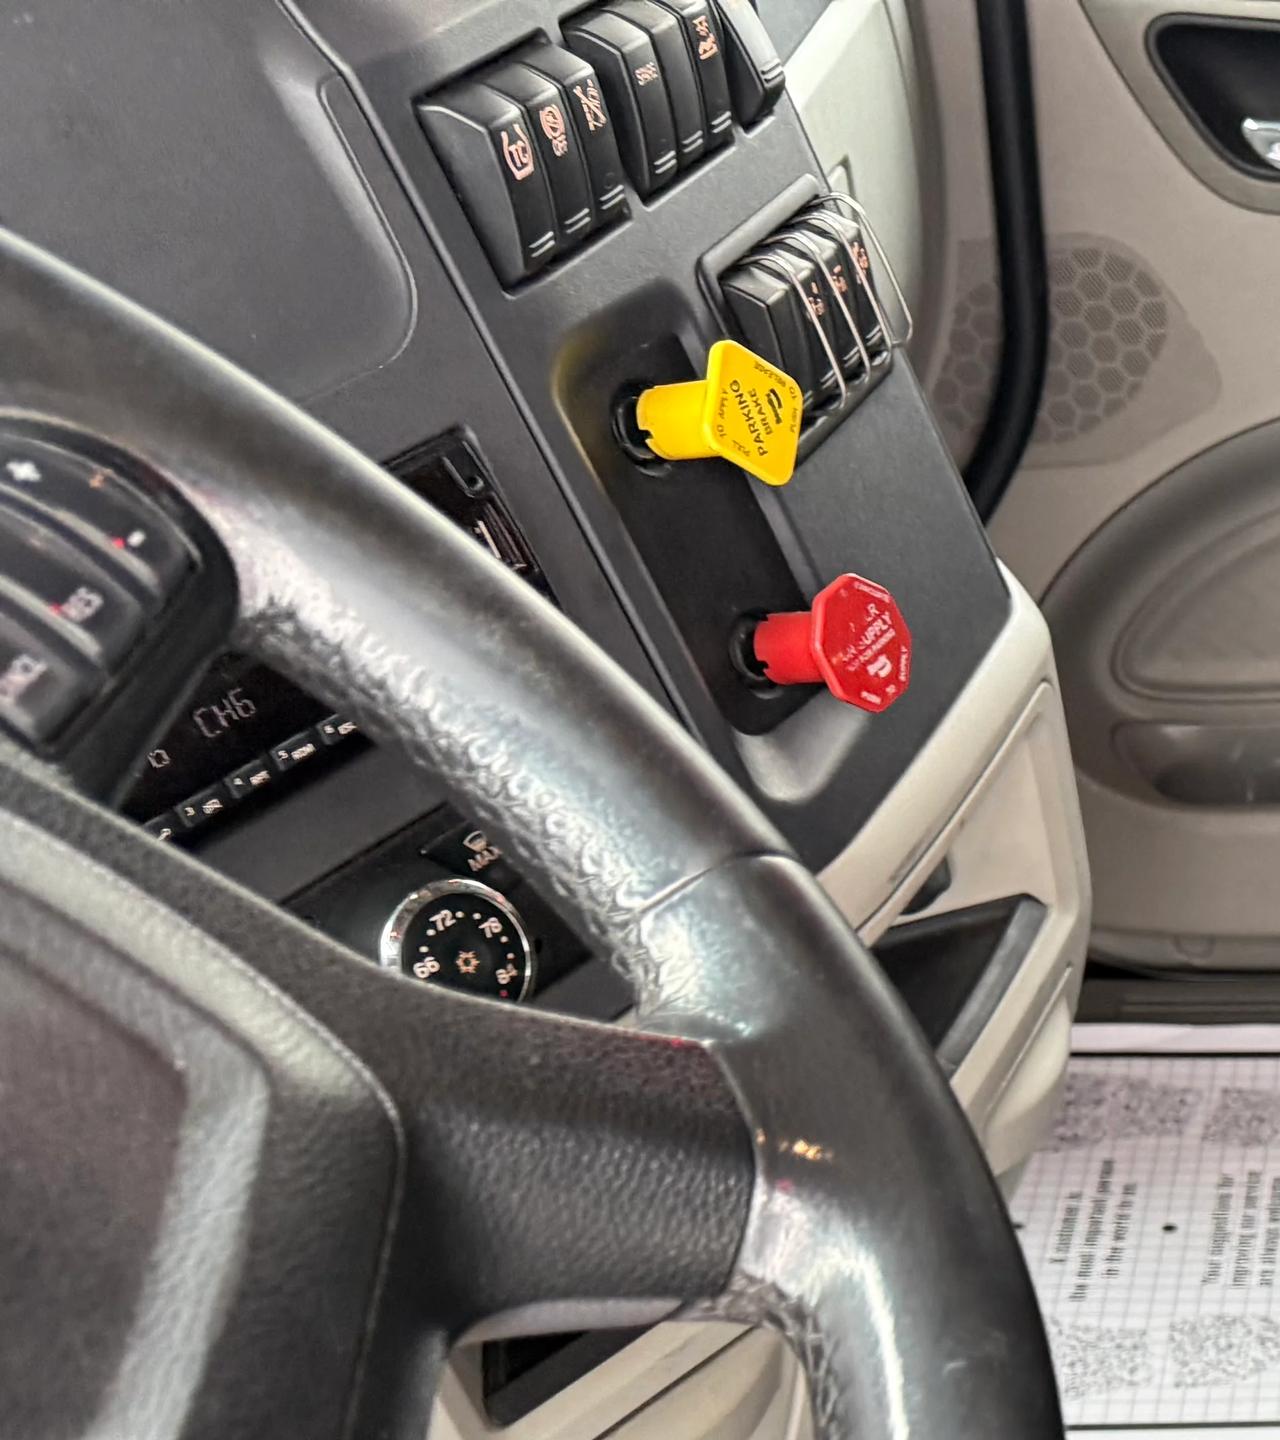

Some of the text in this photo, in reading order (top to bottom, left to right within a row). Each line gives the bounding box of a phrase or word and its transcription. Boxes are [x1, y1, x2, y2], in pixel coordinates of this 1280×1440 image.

[730, 380, 769, 456] PARKING
[748, 388, 773, 435] BRAKE
[192, 687, 257, 738] CH6
[428, 909, 457, 932] 72
[478, 917, 503, 939] 78
[412, 956, 441, 979] 66
[495, 962, 519, 985] 84
